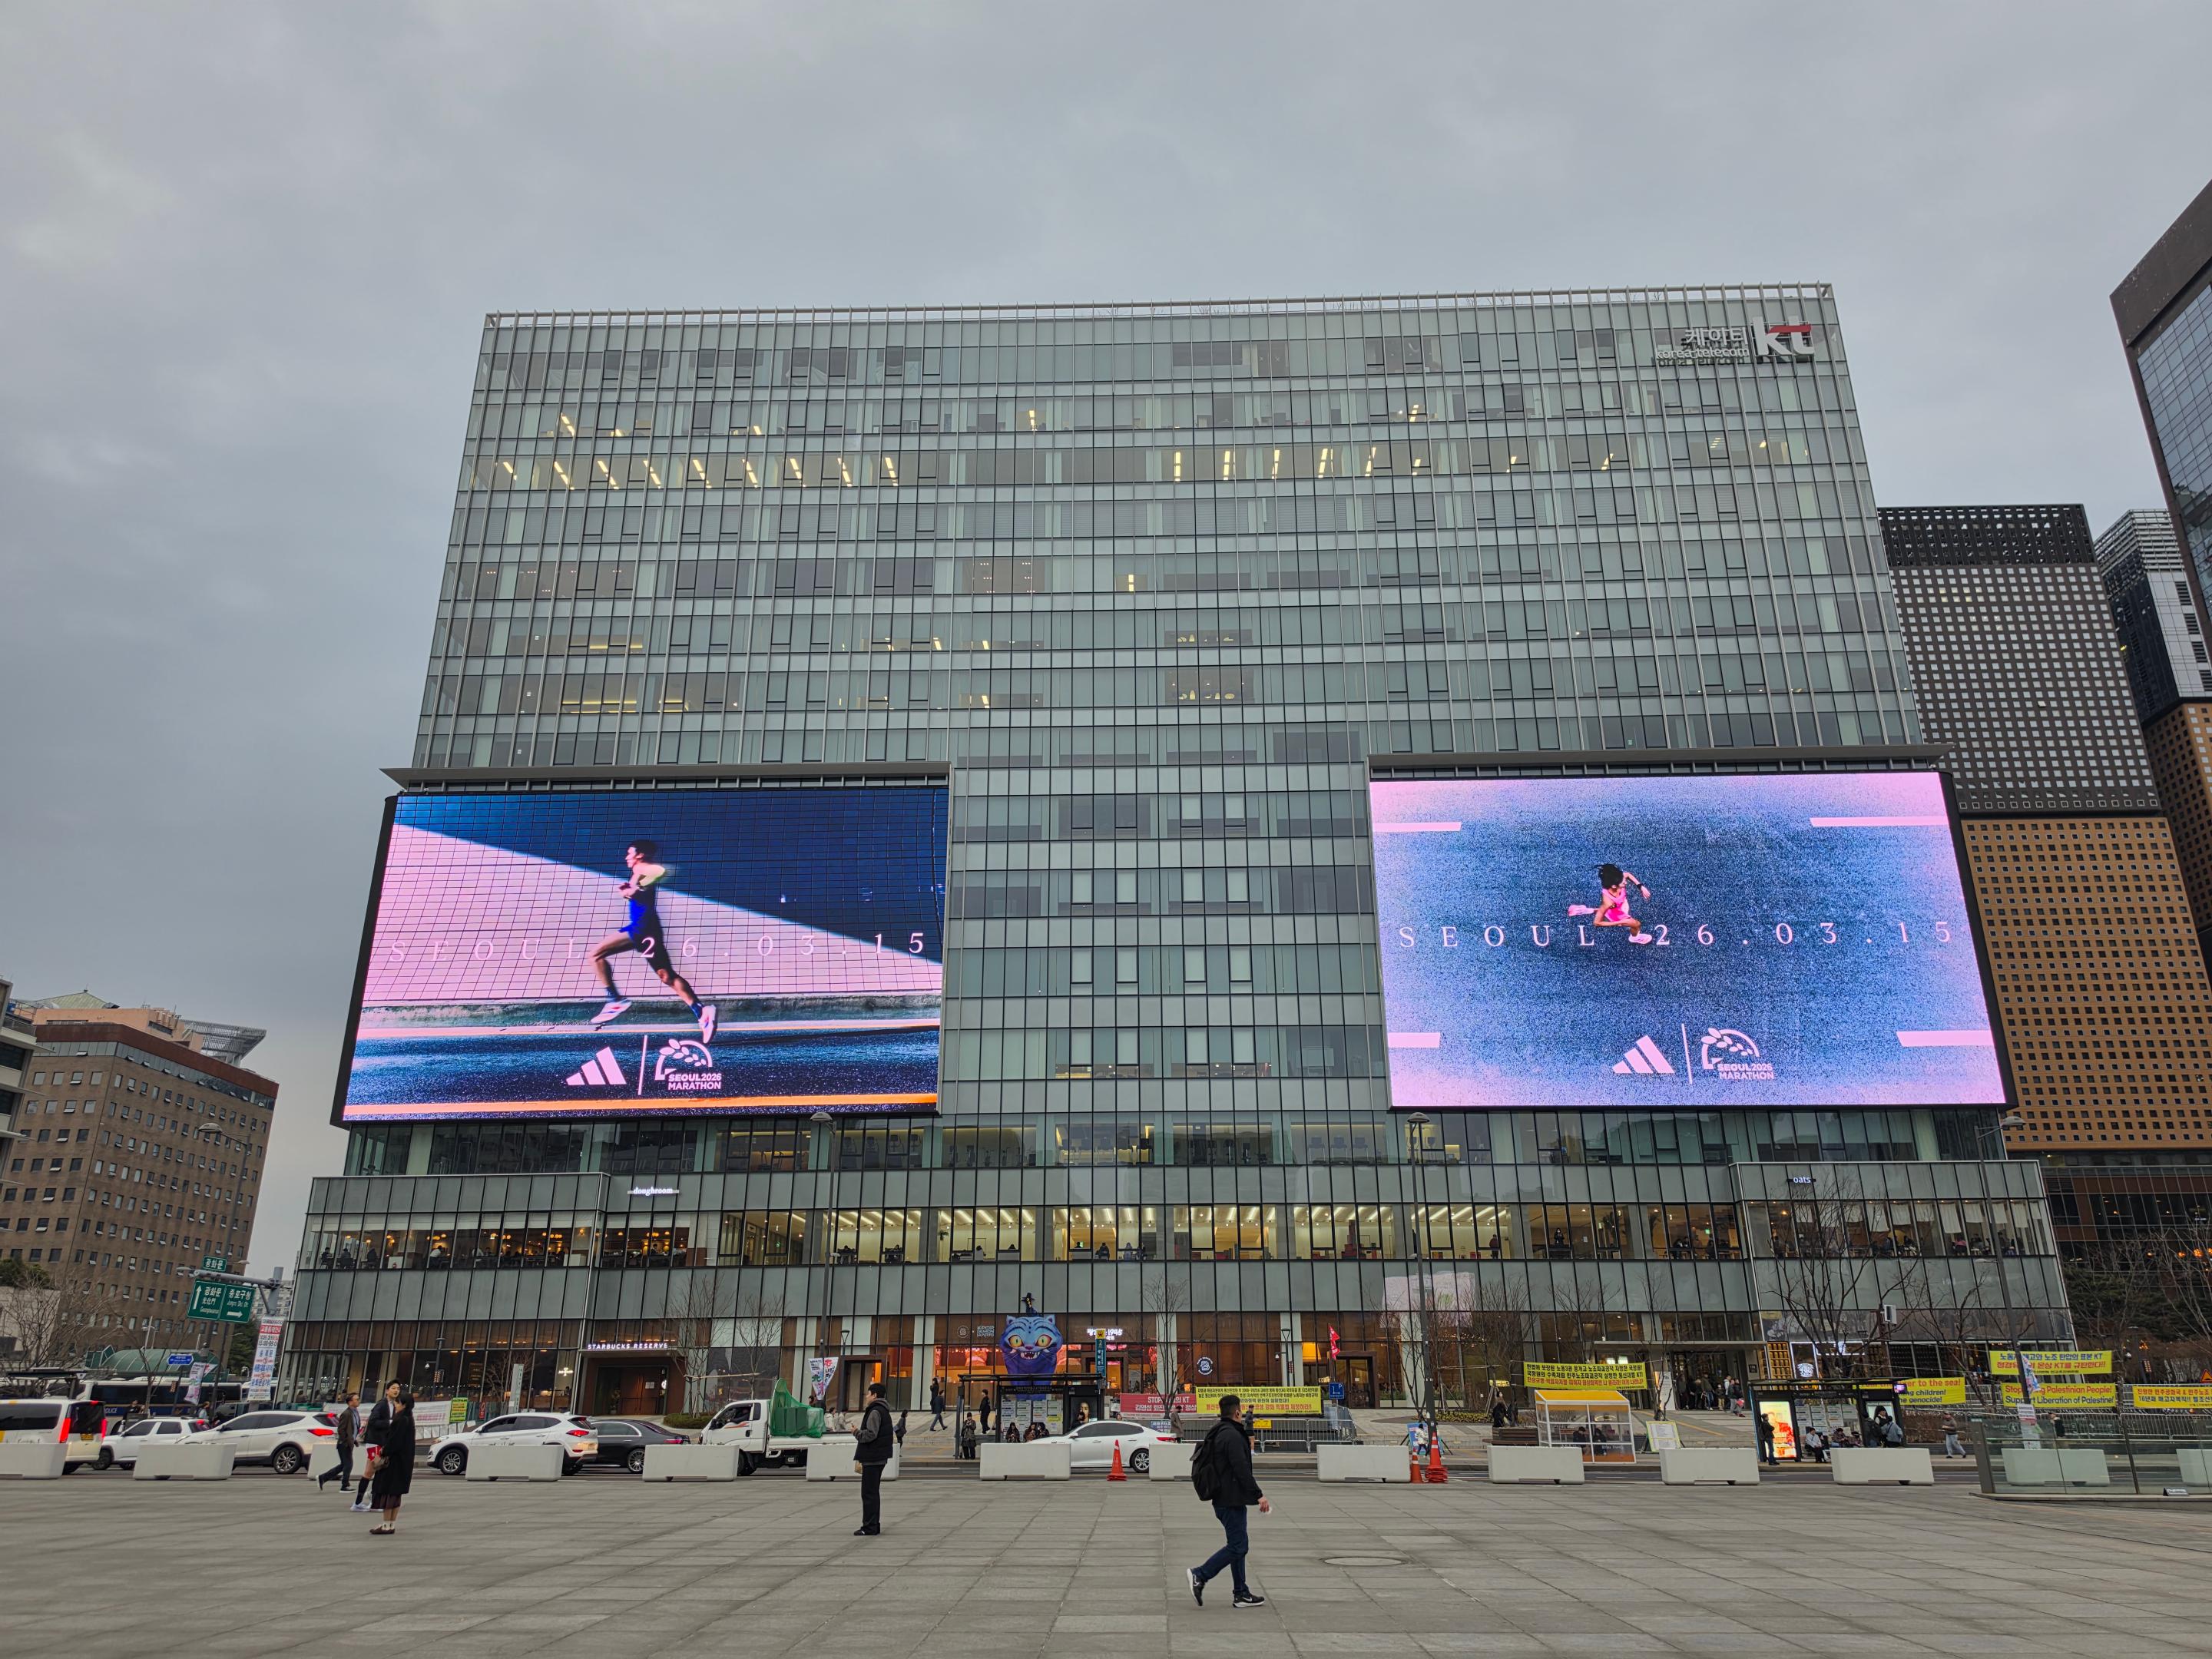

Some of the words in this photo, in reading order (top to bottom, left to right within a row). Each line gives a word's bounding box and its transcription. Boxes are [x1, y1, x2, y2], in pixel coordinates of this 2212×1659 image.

[1751, 316, 1815, 356] kt
[1656, 347, 1692, 359] korea
[1697, 345, 1750, 358] telecom
[1399, 924, 1595, 948] SEOUL
[1719, 1071, 1775, 1081] MARATHON
[667, 1082, 723, 1091] MARATHON
[1793, 1175, 1812, 1184] oats
[633, 1187, 674, 1196] doughroom
[205, 1258, 224, 1270] 광화문
[204, 1286, 222, 1297] 광화문
[228, 1289, 252, 1300] 종로구청
[2047, 1385, 2089, 1393] Palestinian
[2090, 1385, 2112, 1394] People!
[1909, 1396, 1942, 1405] genocide!
[2037, 1396, 2071, 1404] Liberation
[2073, 1396, 2081, 1404] of
[2081, 1396, 2114, 1404] Palestine!
